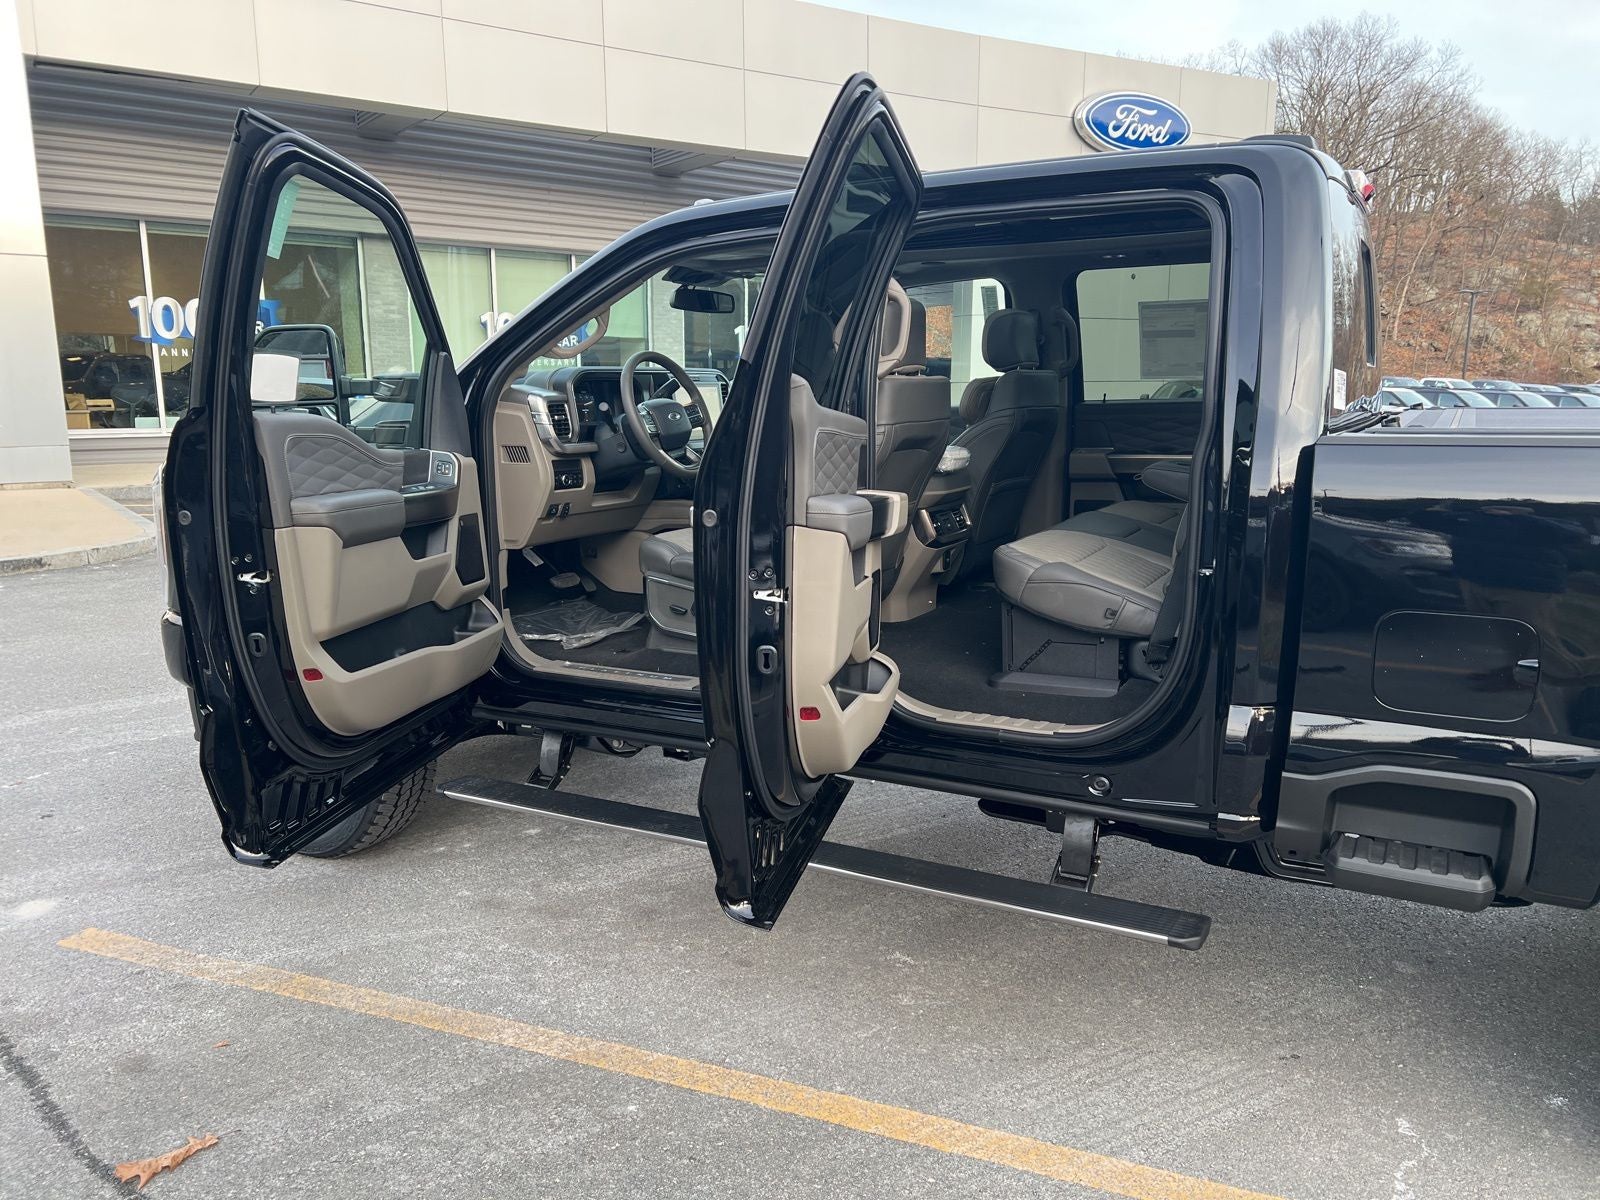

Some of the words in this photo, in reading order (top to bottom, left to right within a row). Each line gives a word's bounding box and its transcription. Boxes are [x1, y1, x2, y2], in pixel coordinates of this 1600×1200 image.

[1108, 104, 1172, 144] Ford
[556, 334, 579, 348] AR
[160, 347, 194, 357] ANN
[530, 358, 576, 368] ERSARY
